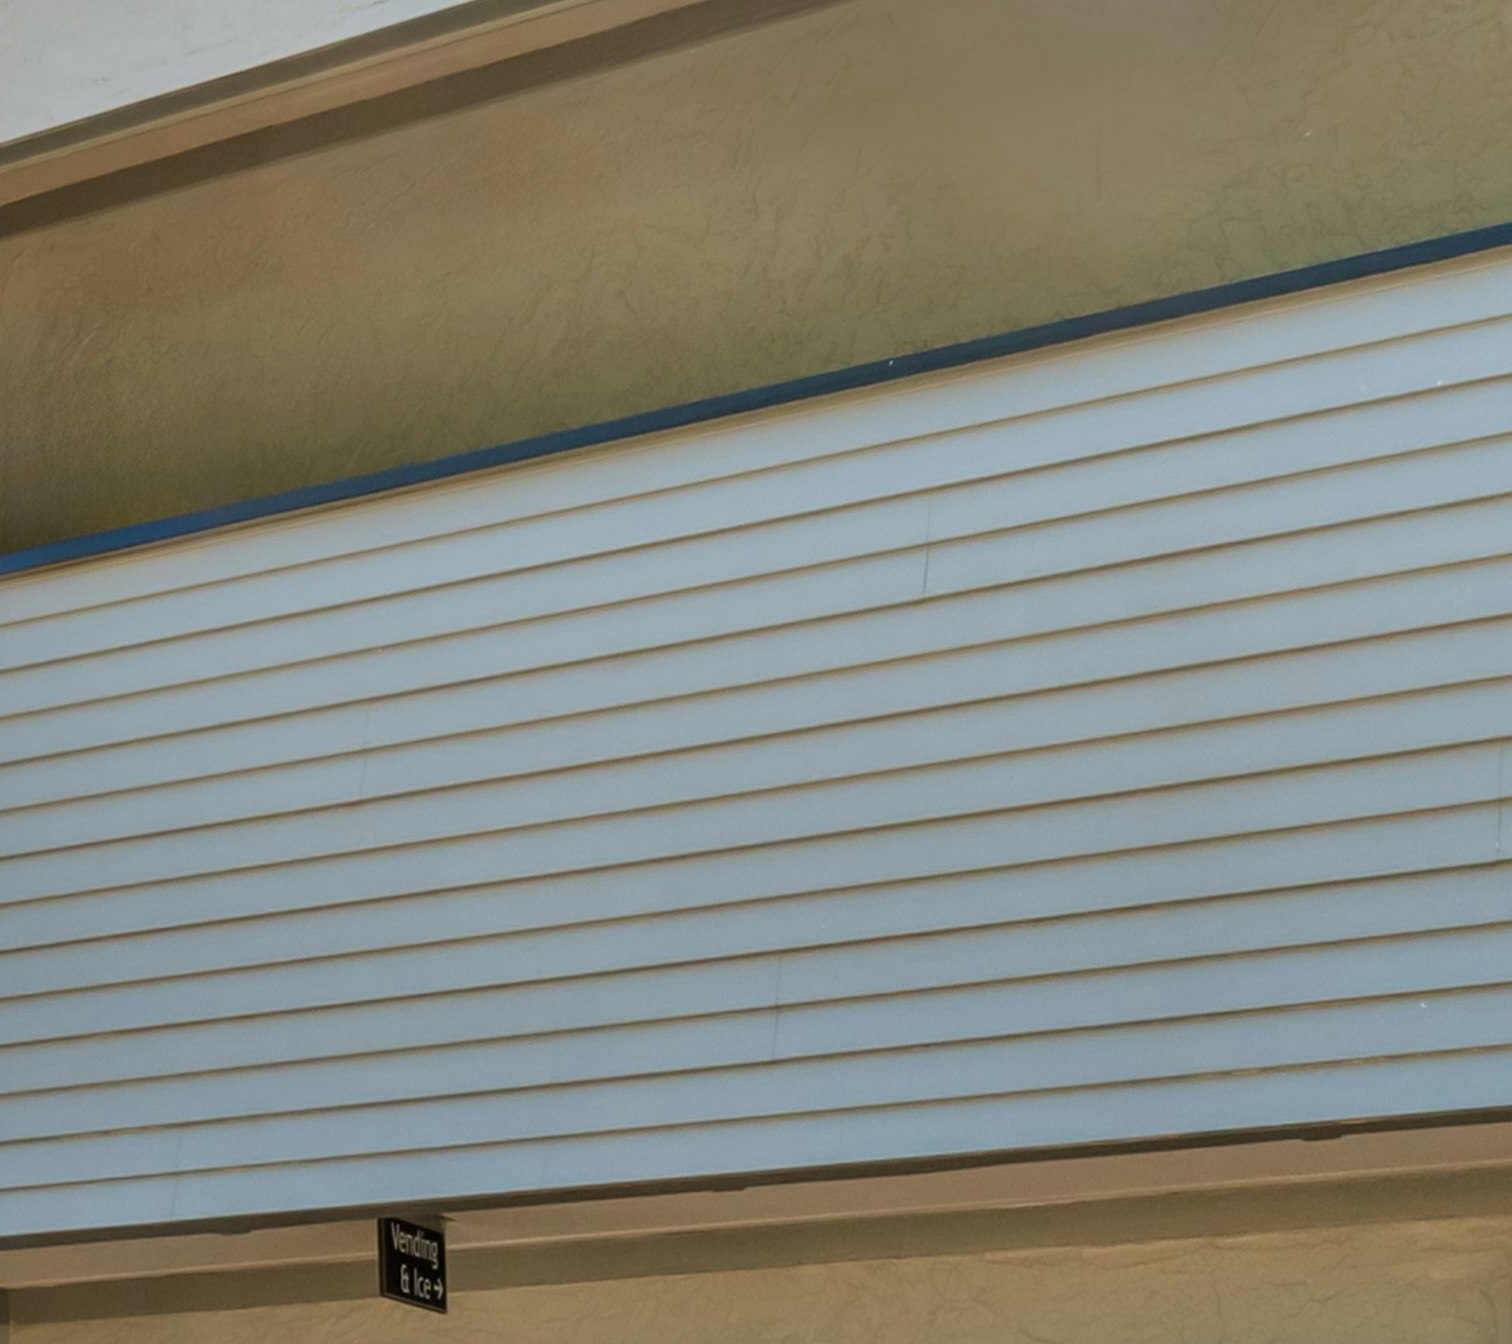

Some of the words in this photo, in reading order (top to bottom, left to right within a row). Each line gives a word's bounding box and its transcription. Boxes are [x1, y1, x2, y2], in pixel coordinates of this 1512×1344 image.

[390, 1222, 439, 1269] Vending
[400, 1264, 410, 1293] &
[414, 1267, 432, 1299] Ice
